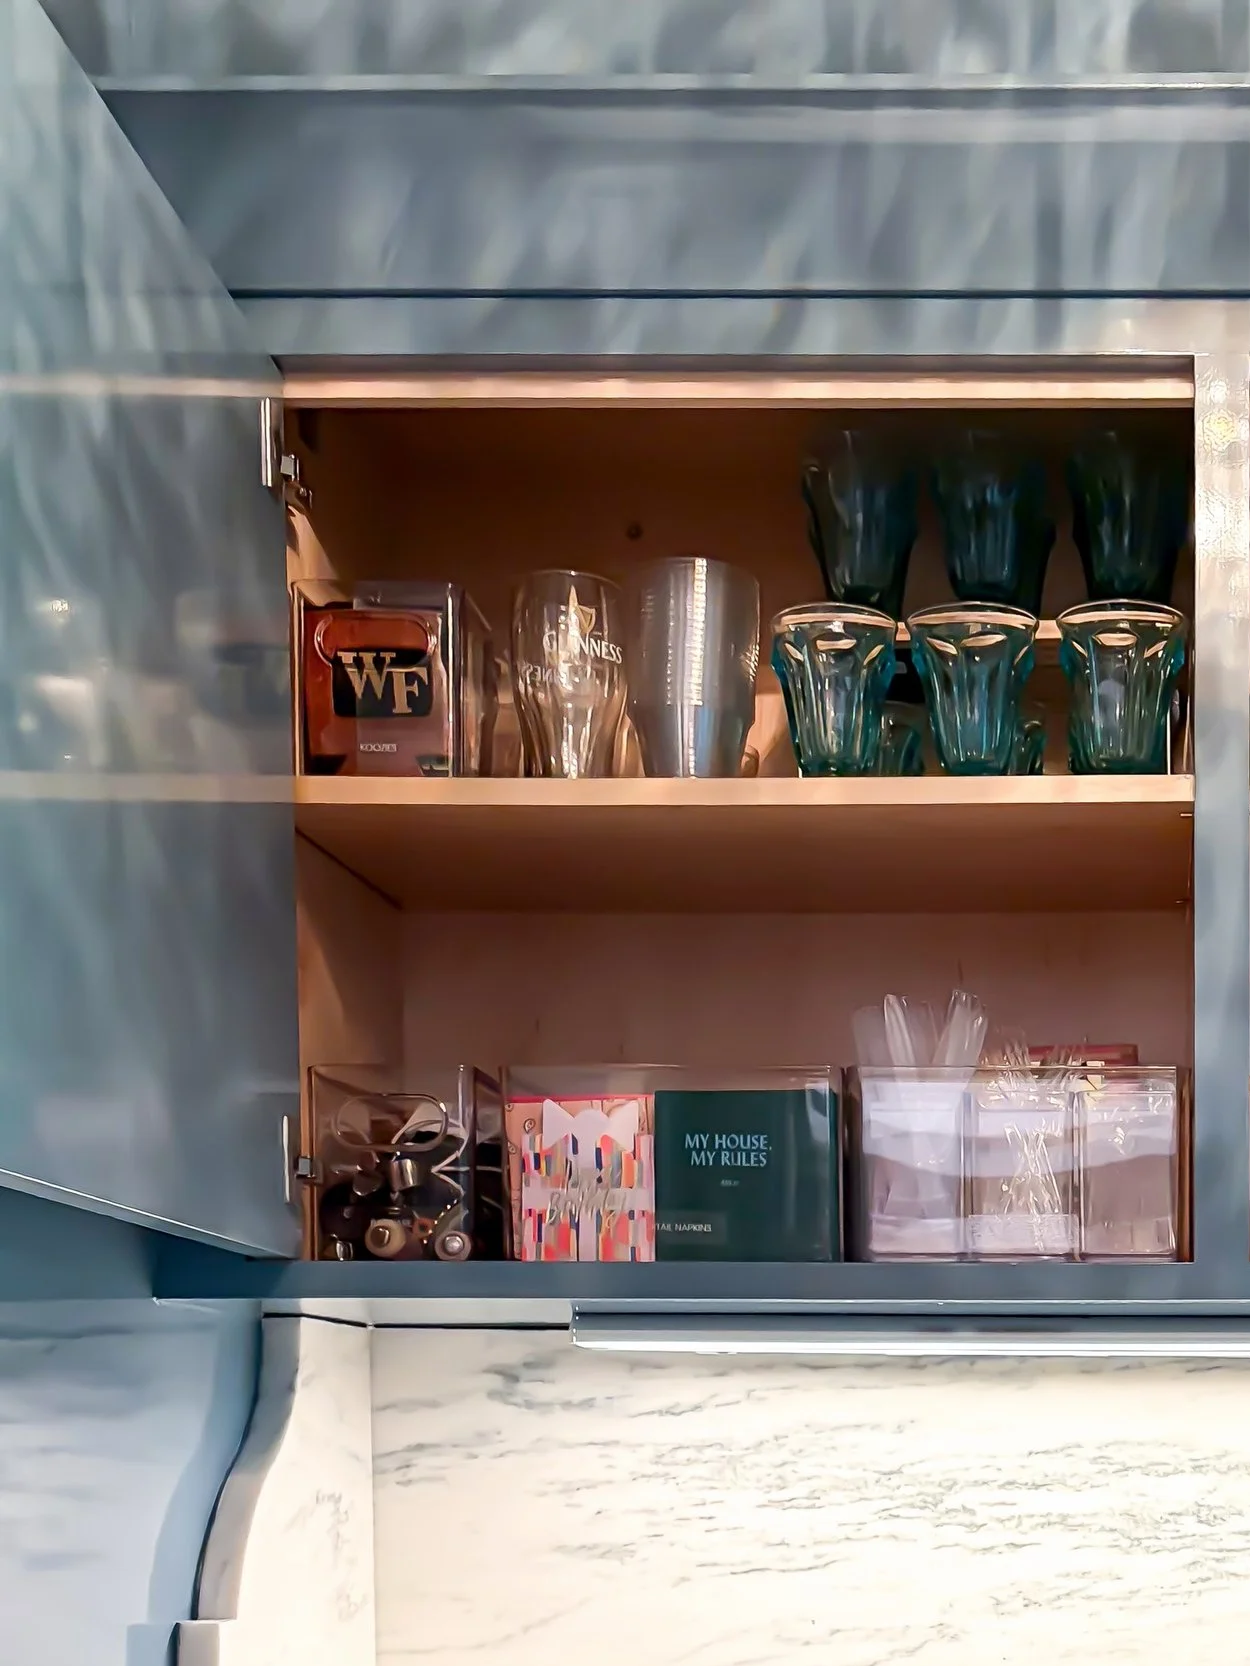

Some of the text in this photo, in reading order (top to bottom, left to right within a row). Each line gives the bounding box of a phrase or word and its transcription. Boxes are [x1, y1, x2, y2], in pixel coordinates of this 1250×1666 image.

[543, 631, 623, 664] GNNESS
[337, 651, 428, 714] WF
[684, 1133, 709, 1150] MY
[690, 1150, 767, 1168] MY RULES
[674, 1223, 712, 1233] NAPKINS
